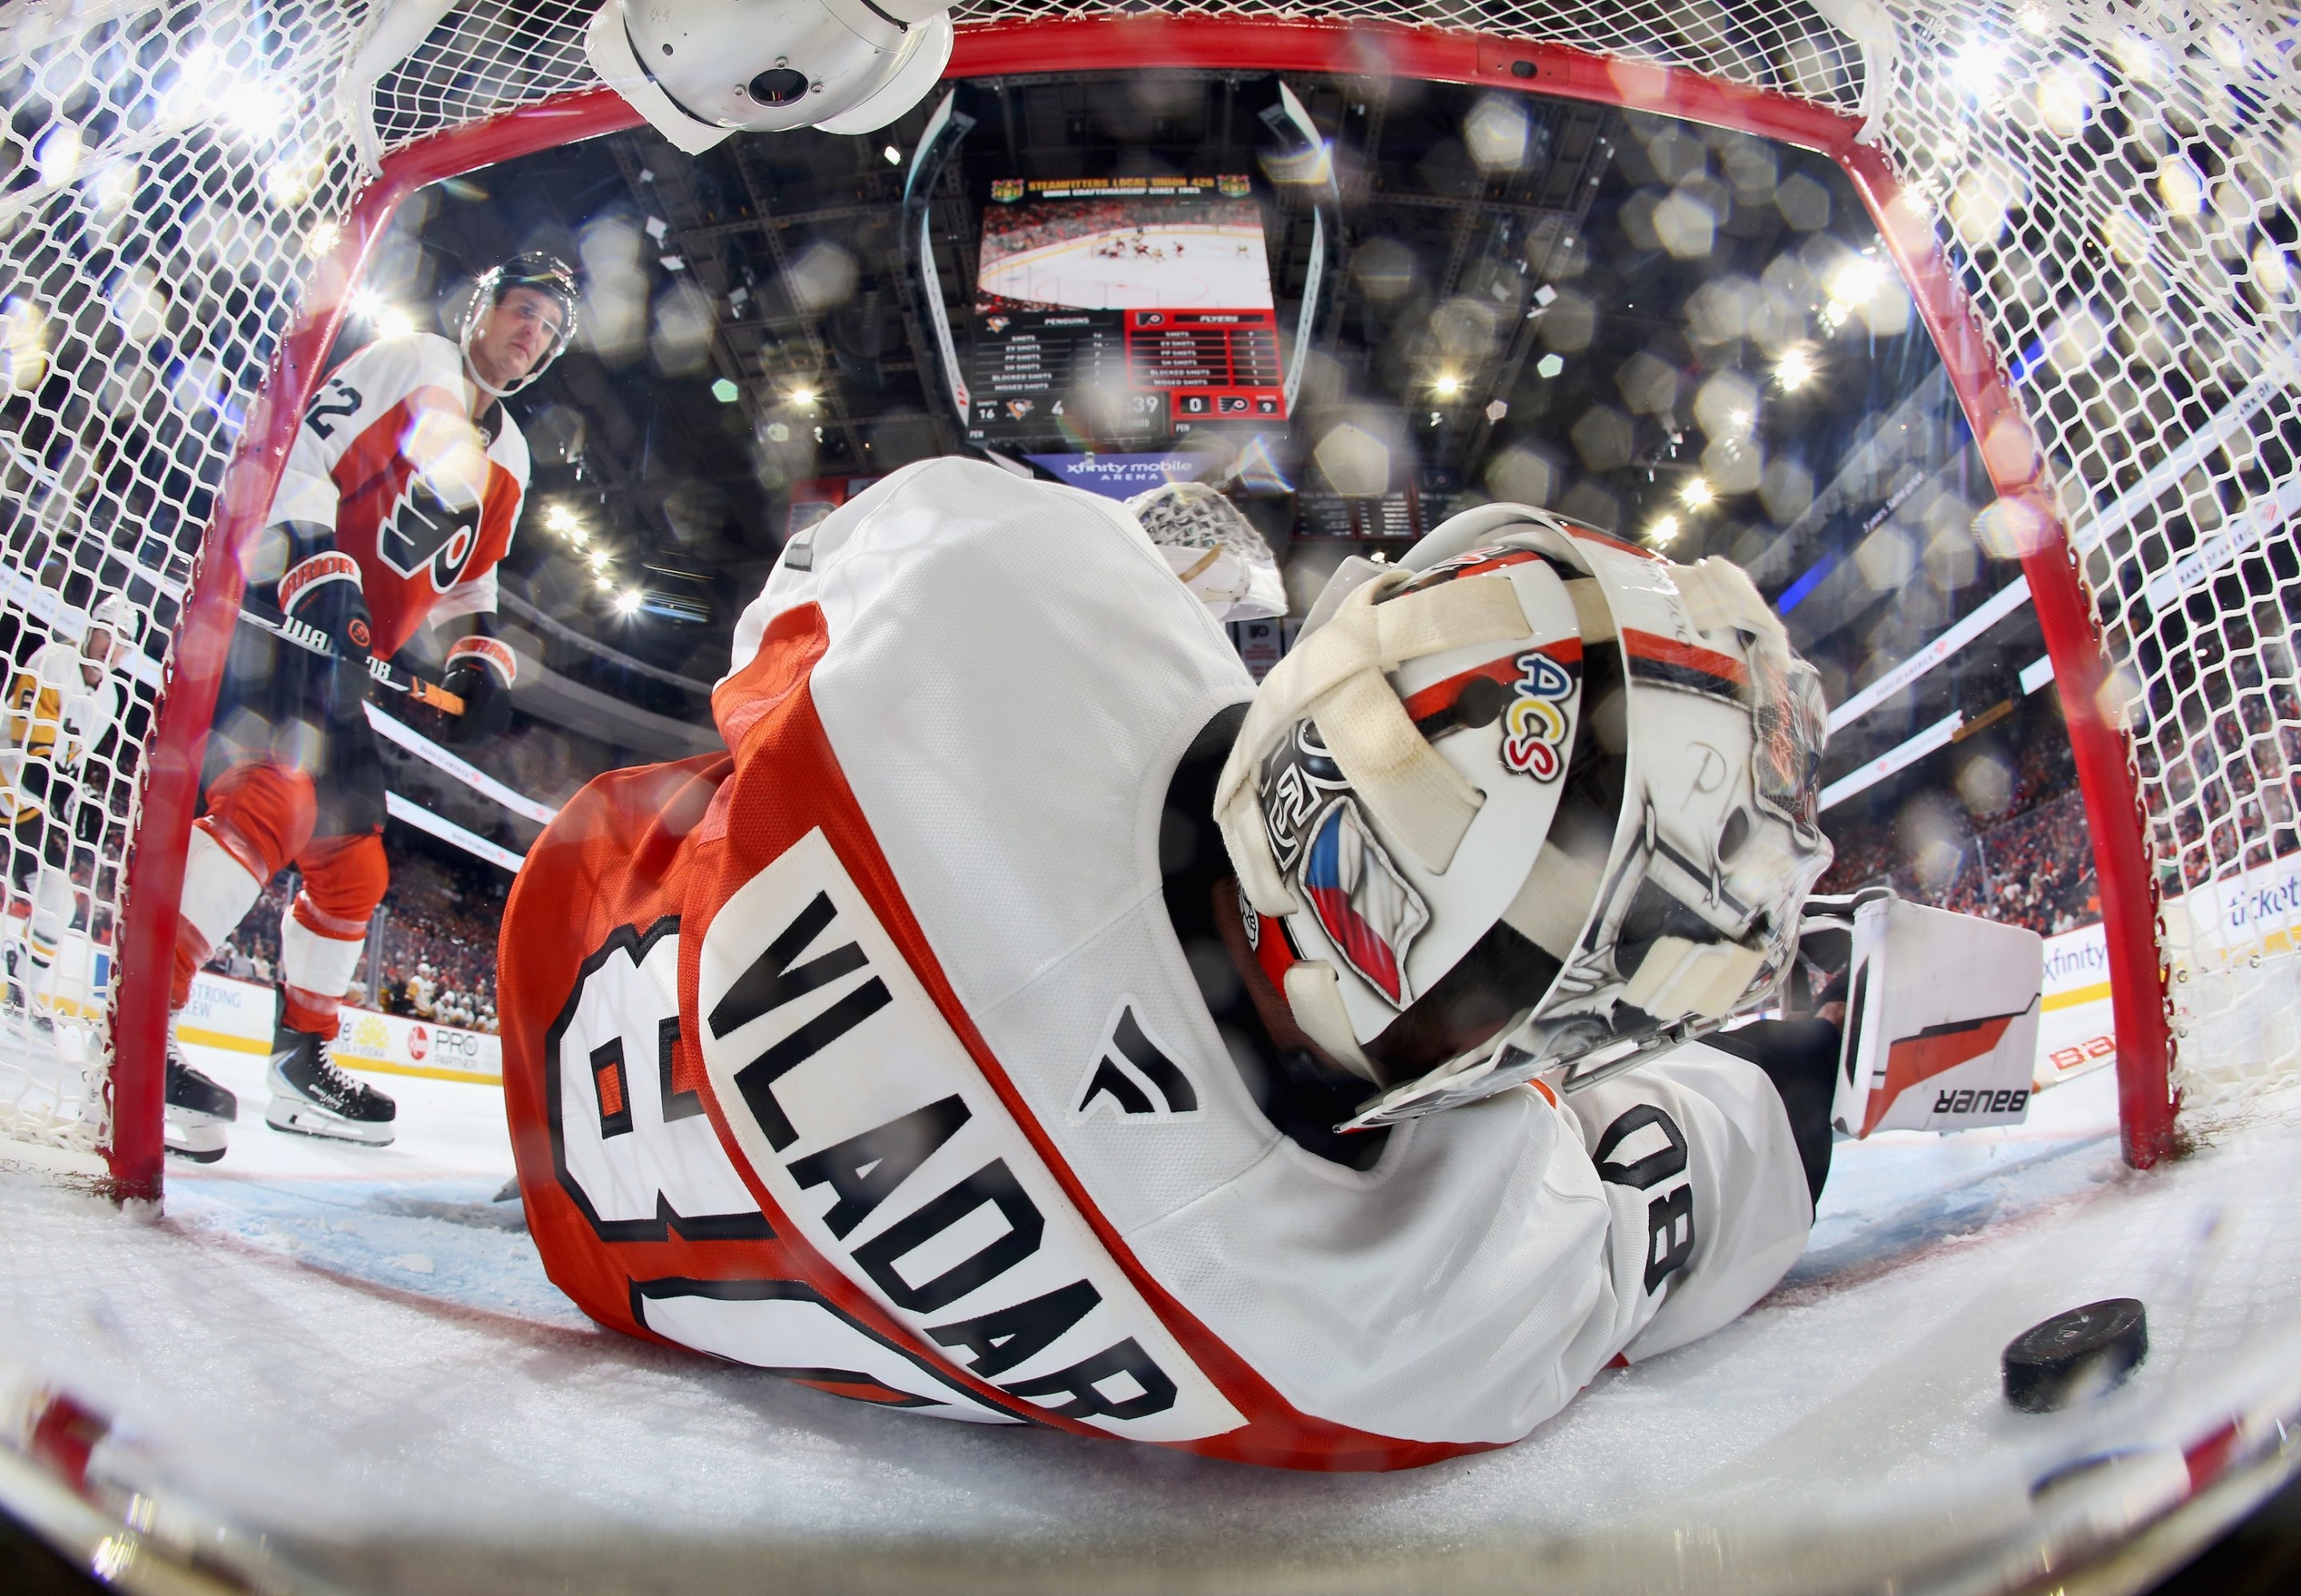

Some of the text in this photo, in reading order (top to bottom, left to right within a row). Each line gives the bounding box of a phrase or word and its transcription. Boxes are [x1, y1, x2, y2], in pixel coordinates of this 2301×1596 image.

[1113, 177, 1147, 187] LOCAL
[1044, 317, 1090, 326] PENGUINS
[1051, 400, 1064, 415] 4
[1189, 398, 1202, 412] 0
[1262, 402, 1272, 412] 9
[979, 408, 996, 419] 16
[1175, 424, 1190, 433] PEN
[969, 430, 984, 439] PEN
[1131, 461, 1192, 473] mobile
[1100, 473, 1159, 482] ARENA
[1505, 653, 1572, 782] ACS
[435, 1030, 479, 1057] PRO
[434, 1056, 478, 1070] PARTNER
[707, 890, 1178, 1421] VLADAR
